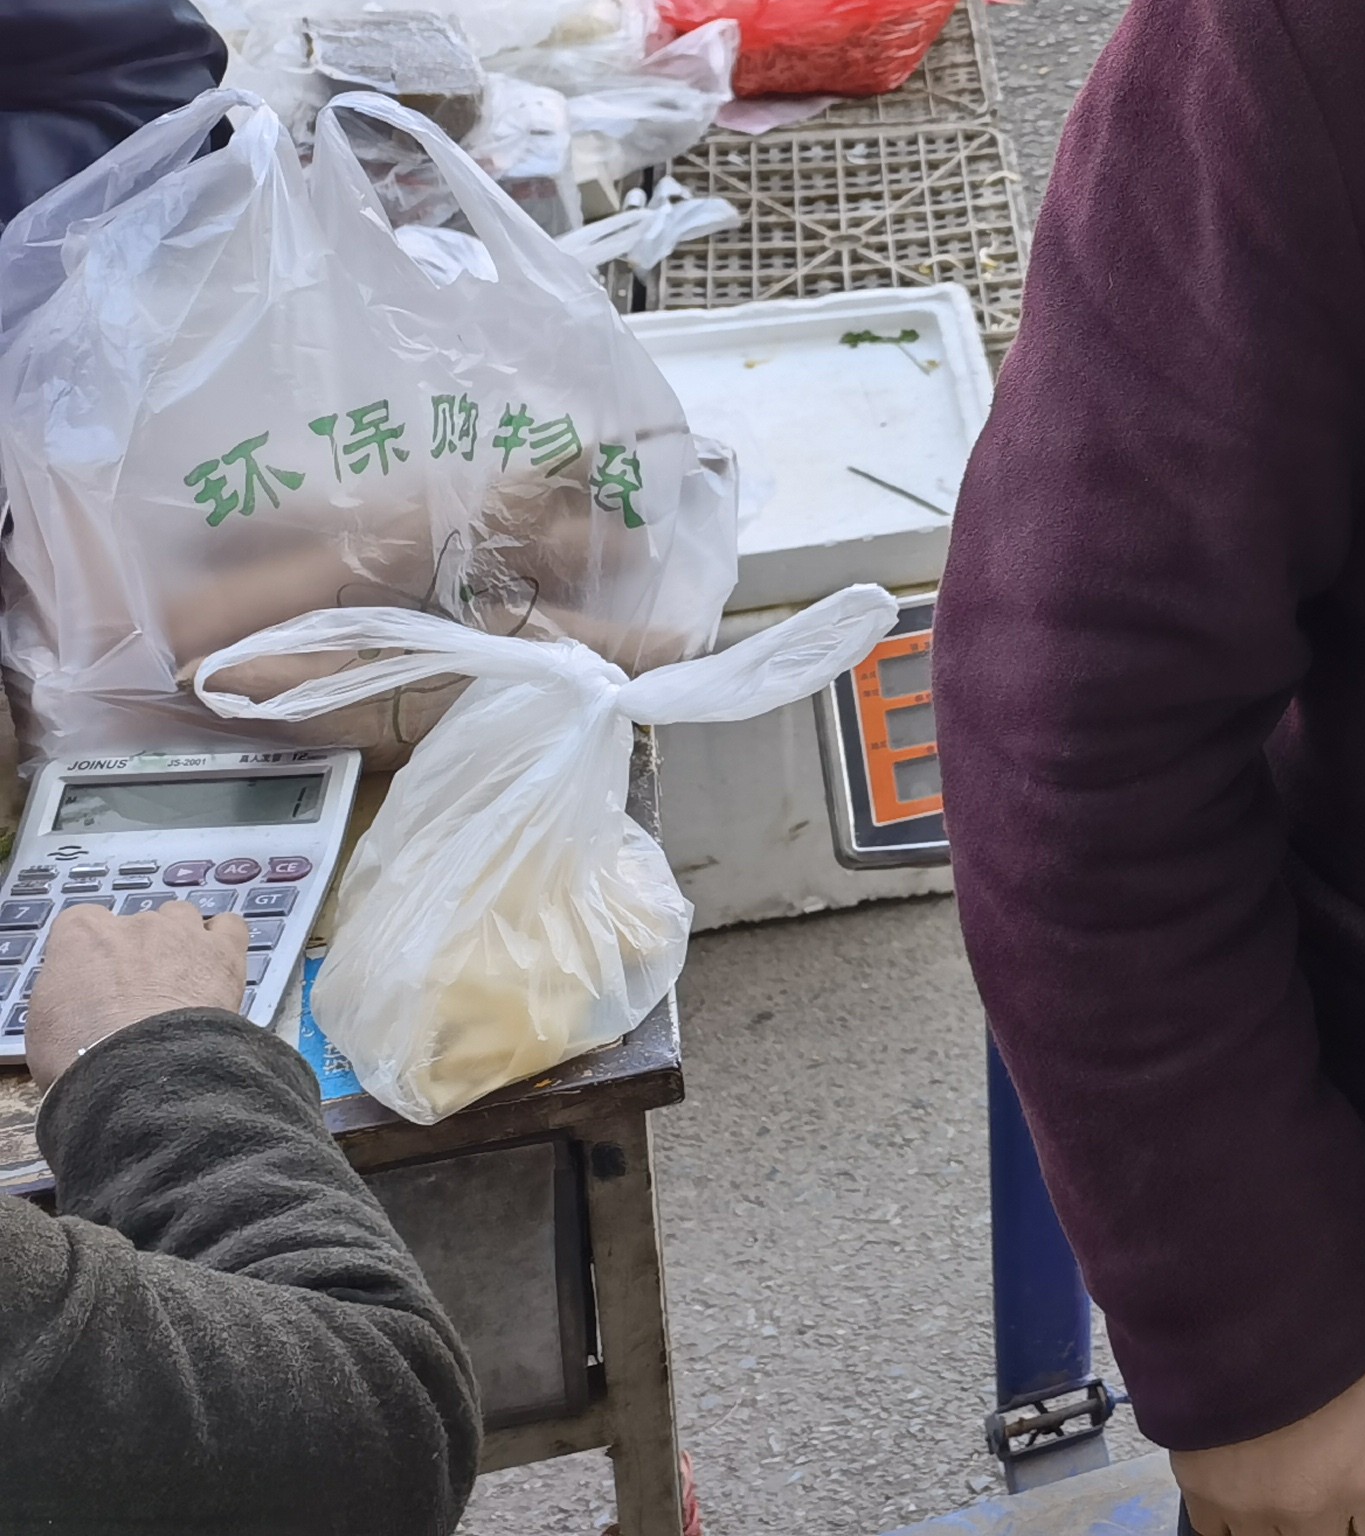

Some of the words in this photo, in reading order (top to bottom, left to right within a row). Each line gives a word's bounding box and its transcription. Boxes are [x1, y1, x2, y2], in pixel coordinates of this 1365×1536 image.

[67, 758, 128, 771] JOINUS
[167, 758, 206, 767] JS-2001
[225, 863, 250, 875] AC
[275, 862, 297, 873] CE
[14, 906, 30, 920] 7
[140, 899, 153, 912] 9
[254, 893, 283, 905] GT
